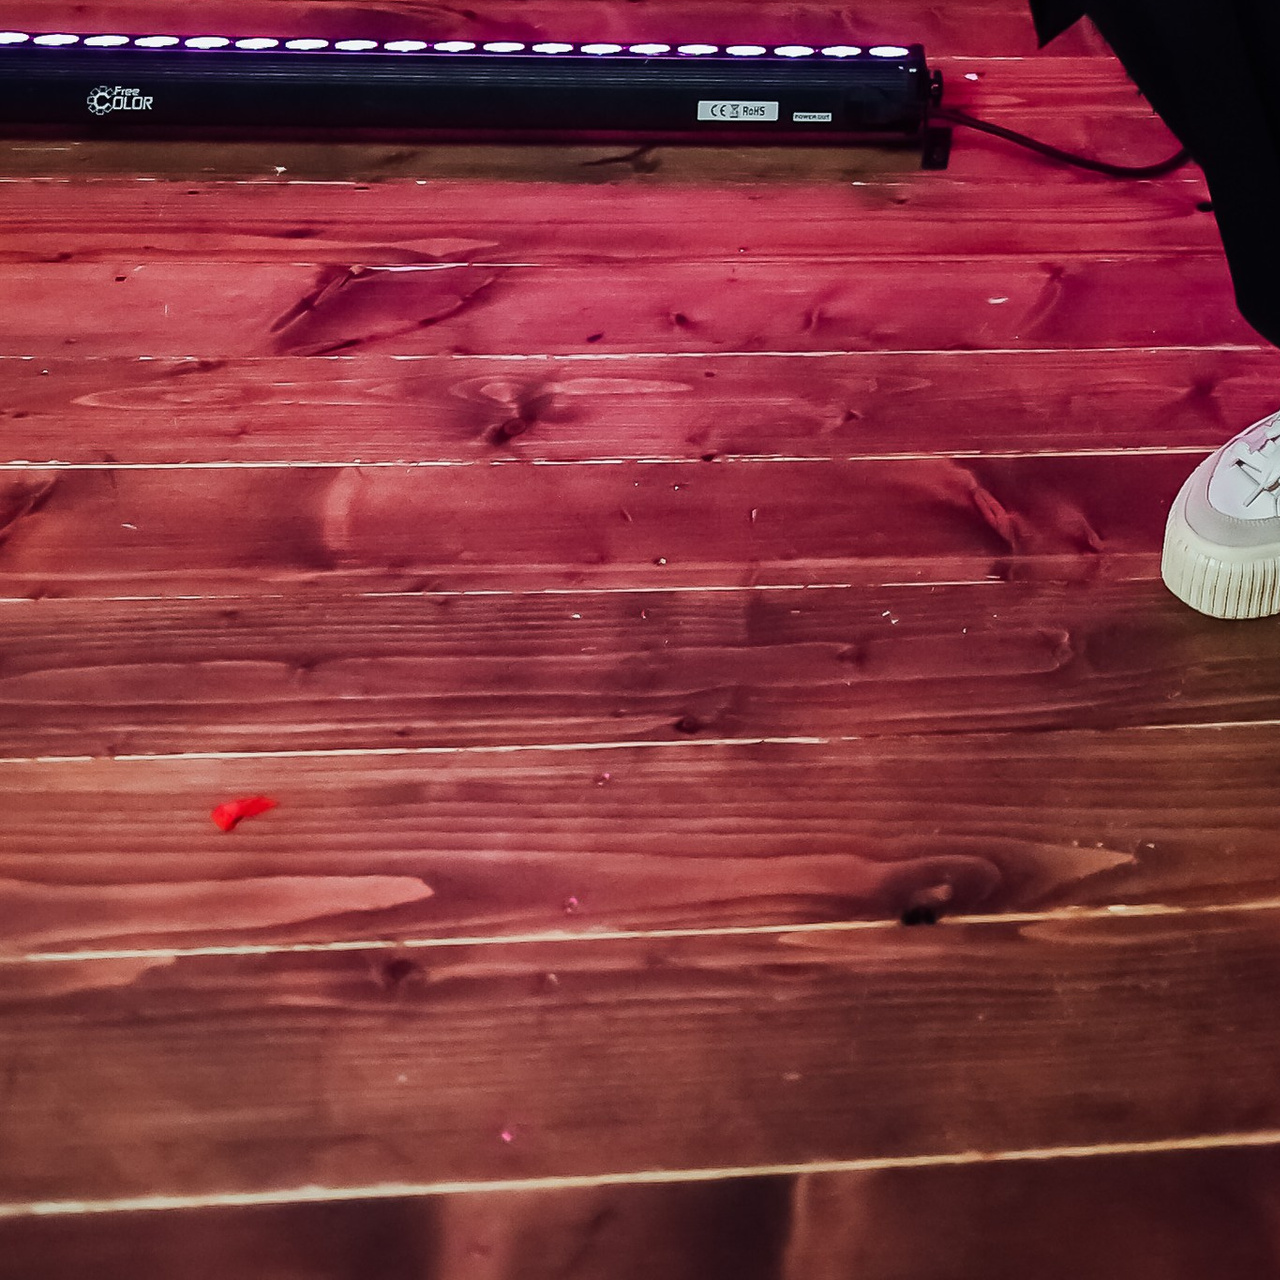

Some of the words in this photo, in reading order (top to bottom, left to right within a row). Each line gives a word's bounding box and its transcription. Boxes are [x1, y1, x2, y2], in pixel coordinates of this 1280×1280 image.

[114, 85, 140, 96] Free
[92, 92, 153, 110] COLOR
[711, 104, 727, 117] CE
[743, 106, 765, 116] RoHS
